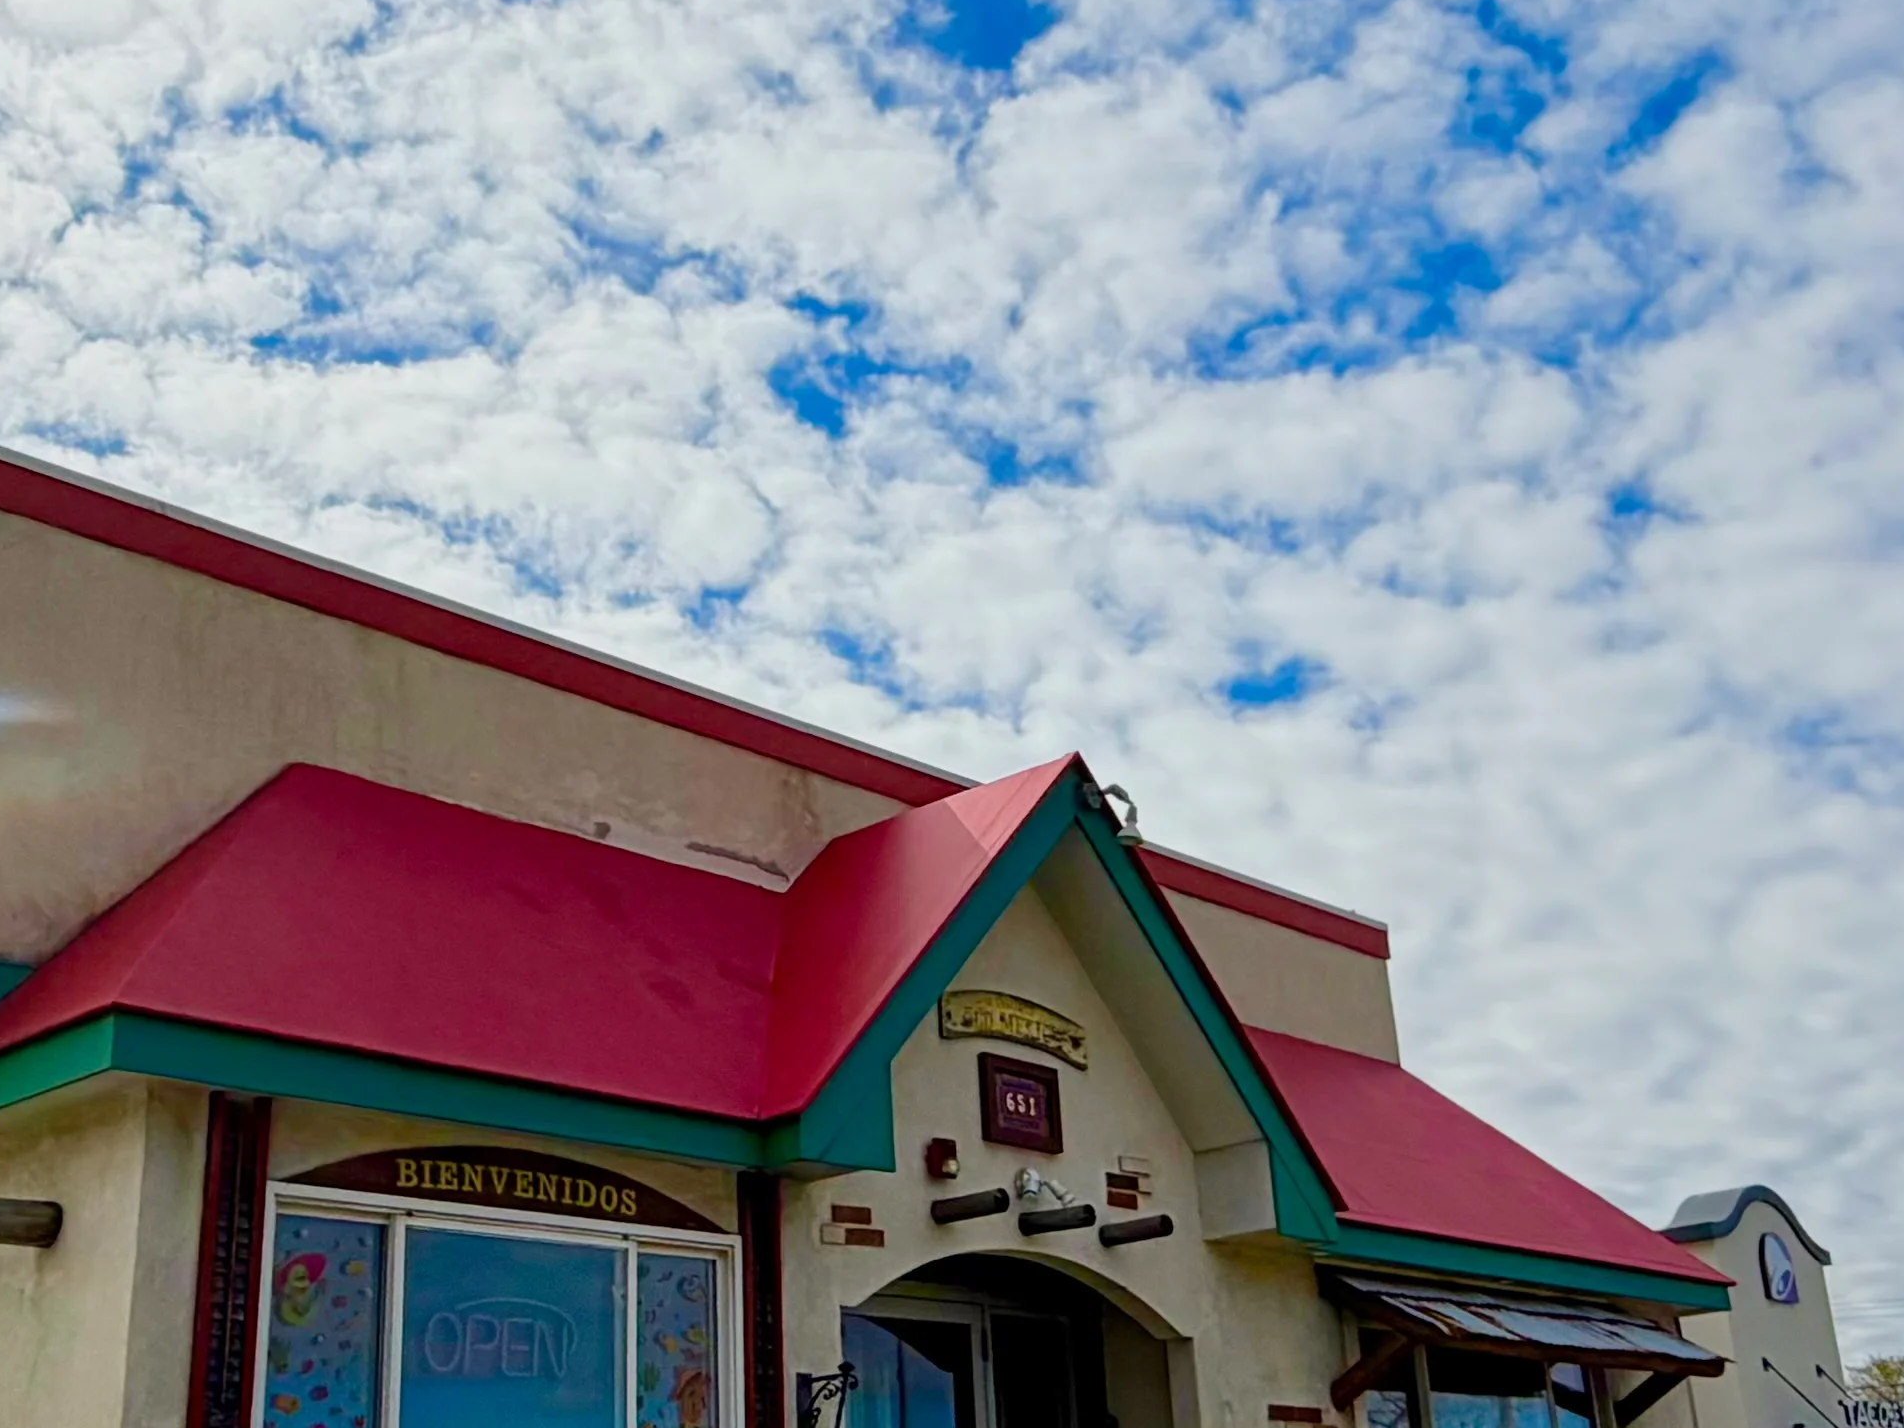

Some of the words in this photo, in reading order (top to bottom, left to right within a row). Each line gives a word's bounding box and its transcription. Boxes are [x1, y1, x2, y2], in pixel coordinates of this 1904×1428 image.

[1006, 1092, 1036, 1117] 651
[396, 1158, 637, 1216] BIENVENIDOS
[425, 1312, 567, 1378] OPEN
